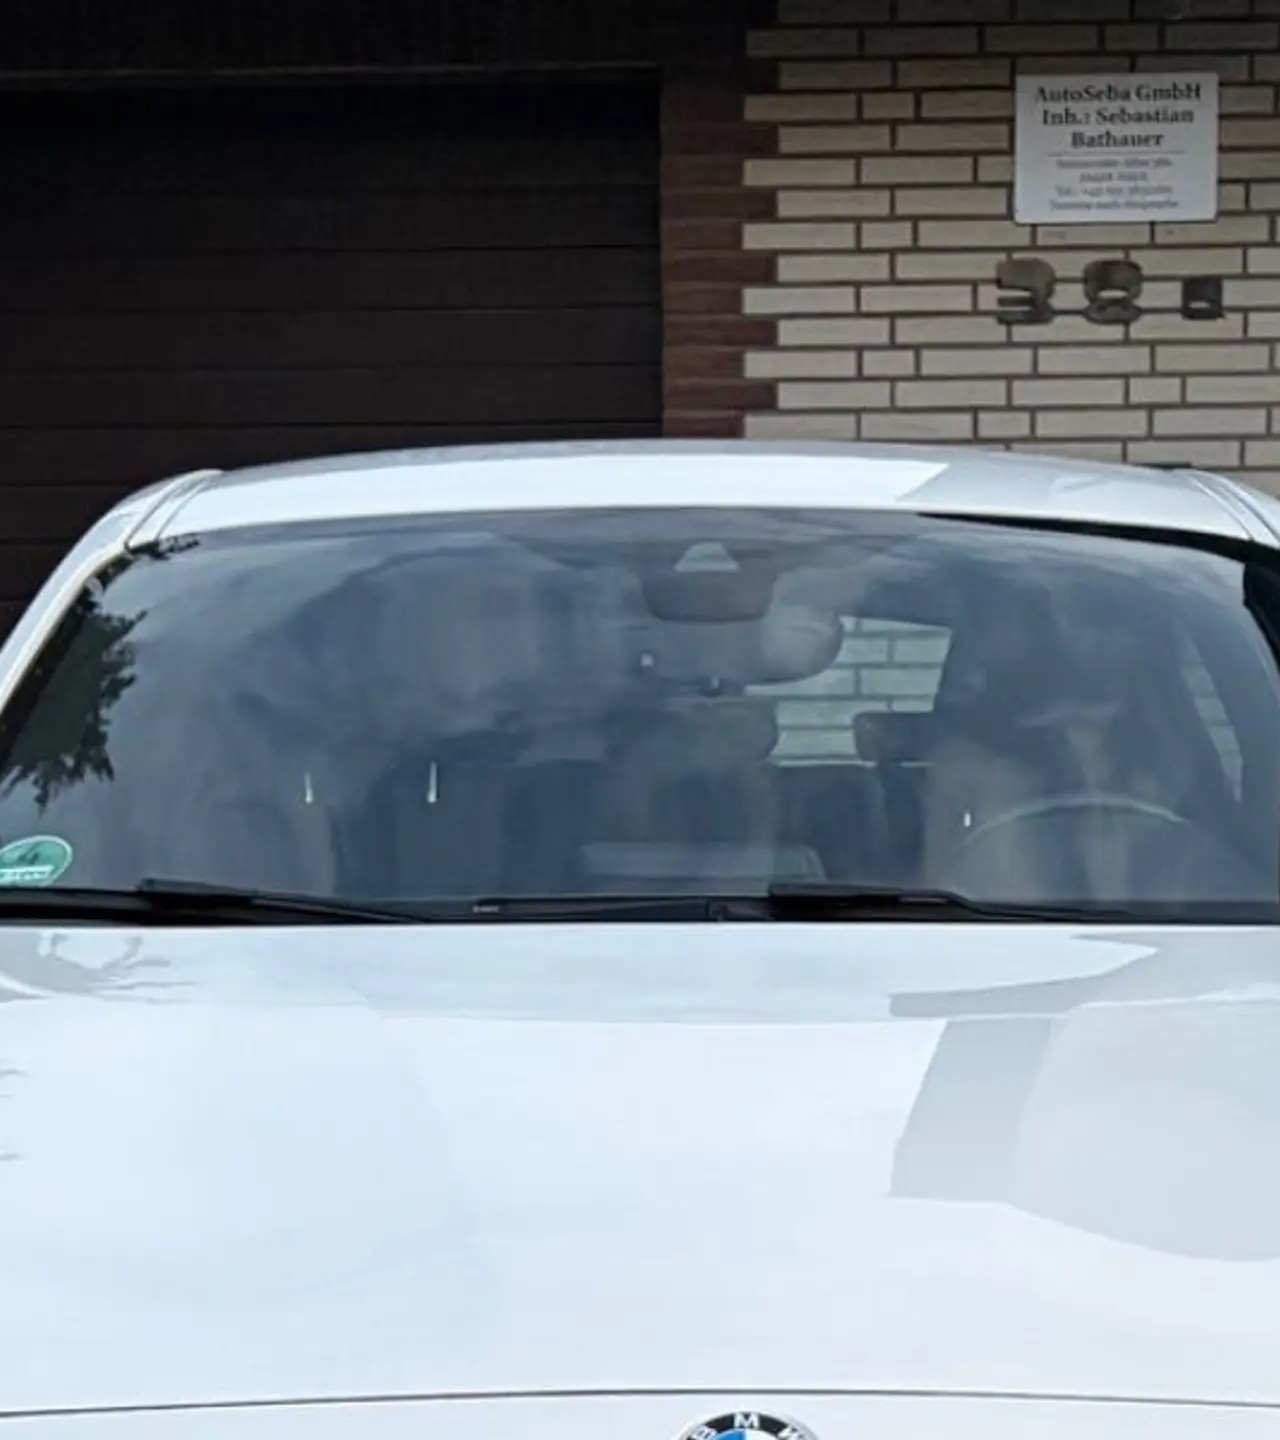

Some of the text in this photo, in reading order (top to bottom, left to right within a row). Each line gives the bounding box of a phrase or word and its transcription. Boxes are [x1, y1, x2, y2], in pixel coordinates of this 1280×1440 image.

[1036, 81, 1201, 103] AutoSeba GmbH
[1096, 106, 1194, 125] Sebastian
